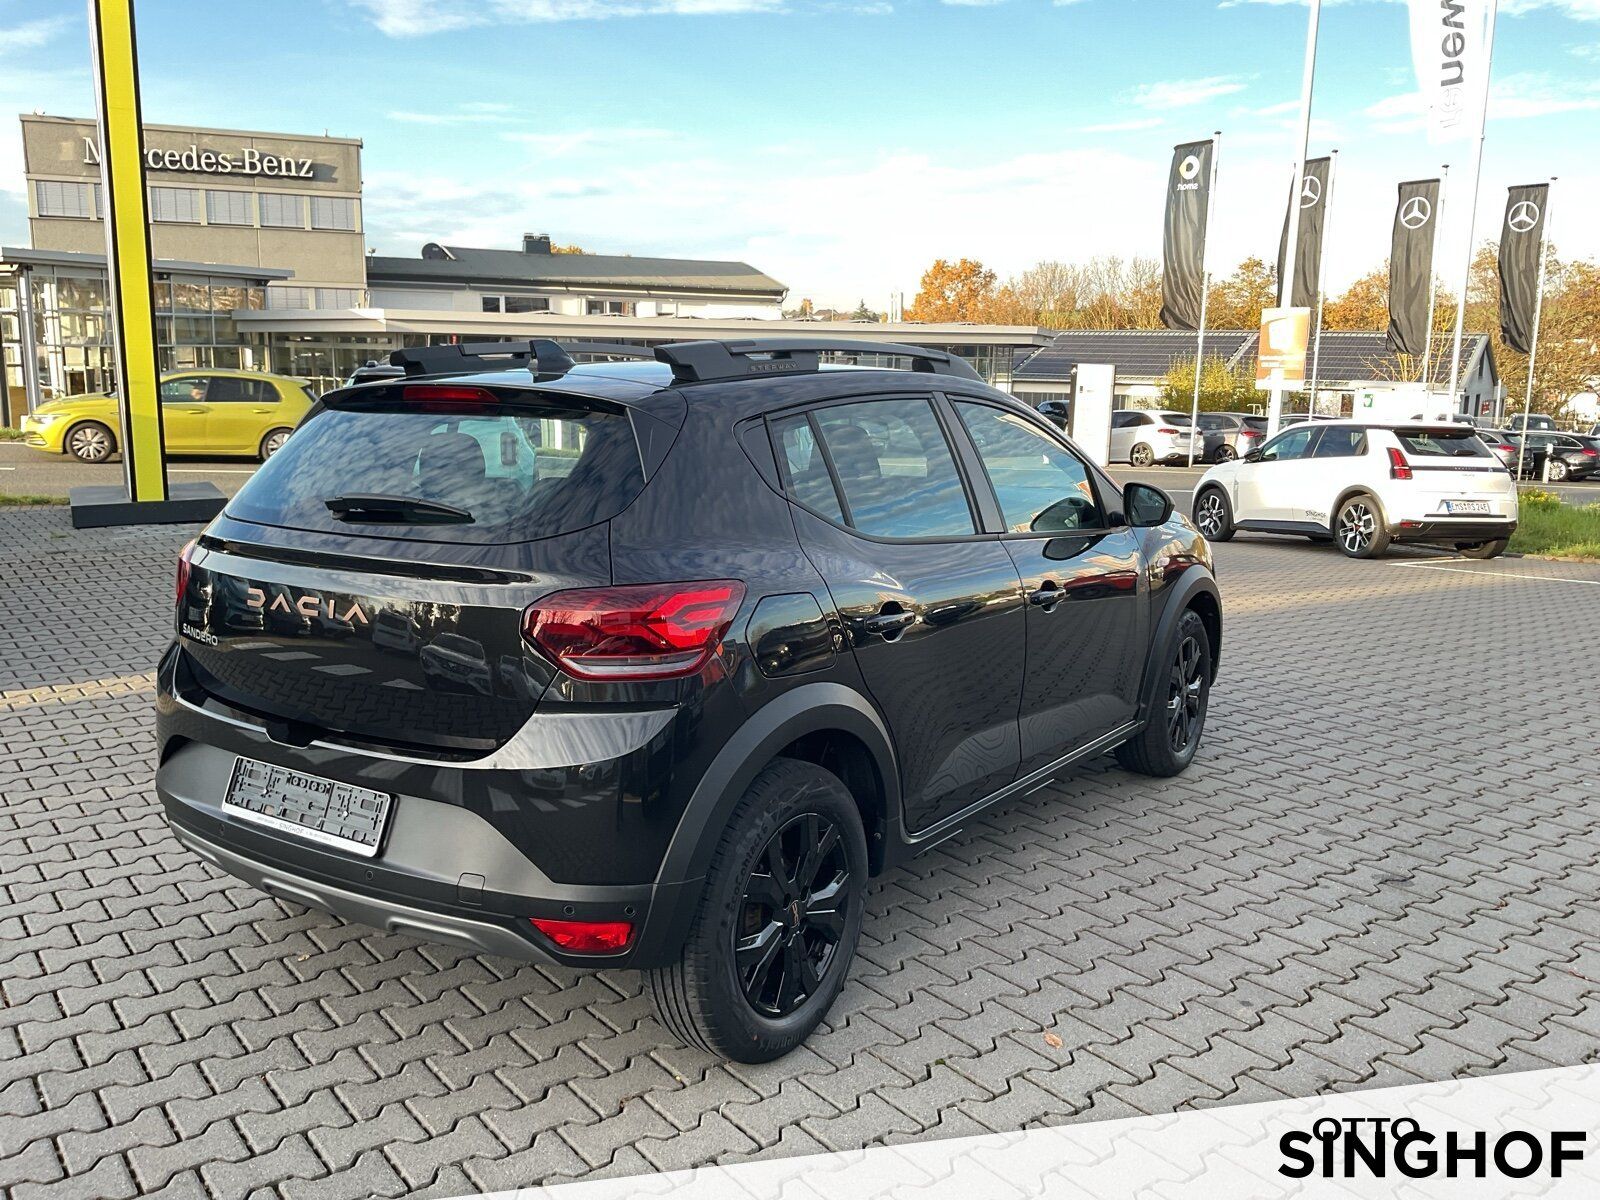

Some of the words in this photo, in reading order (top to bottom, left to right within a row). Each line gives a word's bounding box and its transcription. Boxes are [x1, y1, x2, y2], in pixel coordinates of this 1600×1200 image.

[83, 136, 314, 178] Mcedes-Benz
[751, 361, 798, 372] STEPWAY
[247, 588, 369, 624] DACIA
[182, 623, 218, 647] SANDERO
